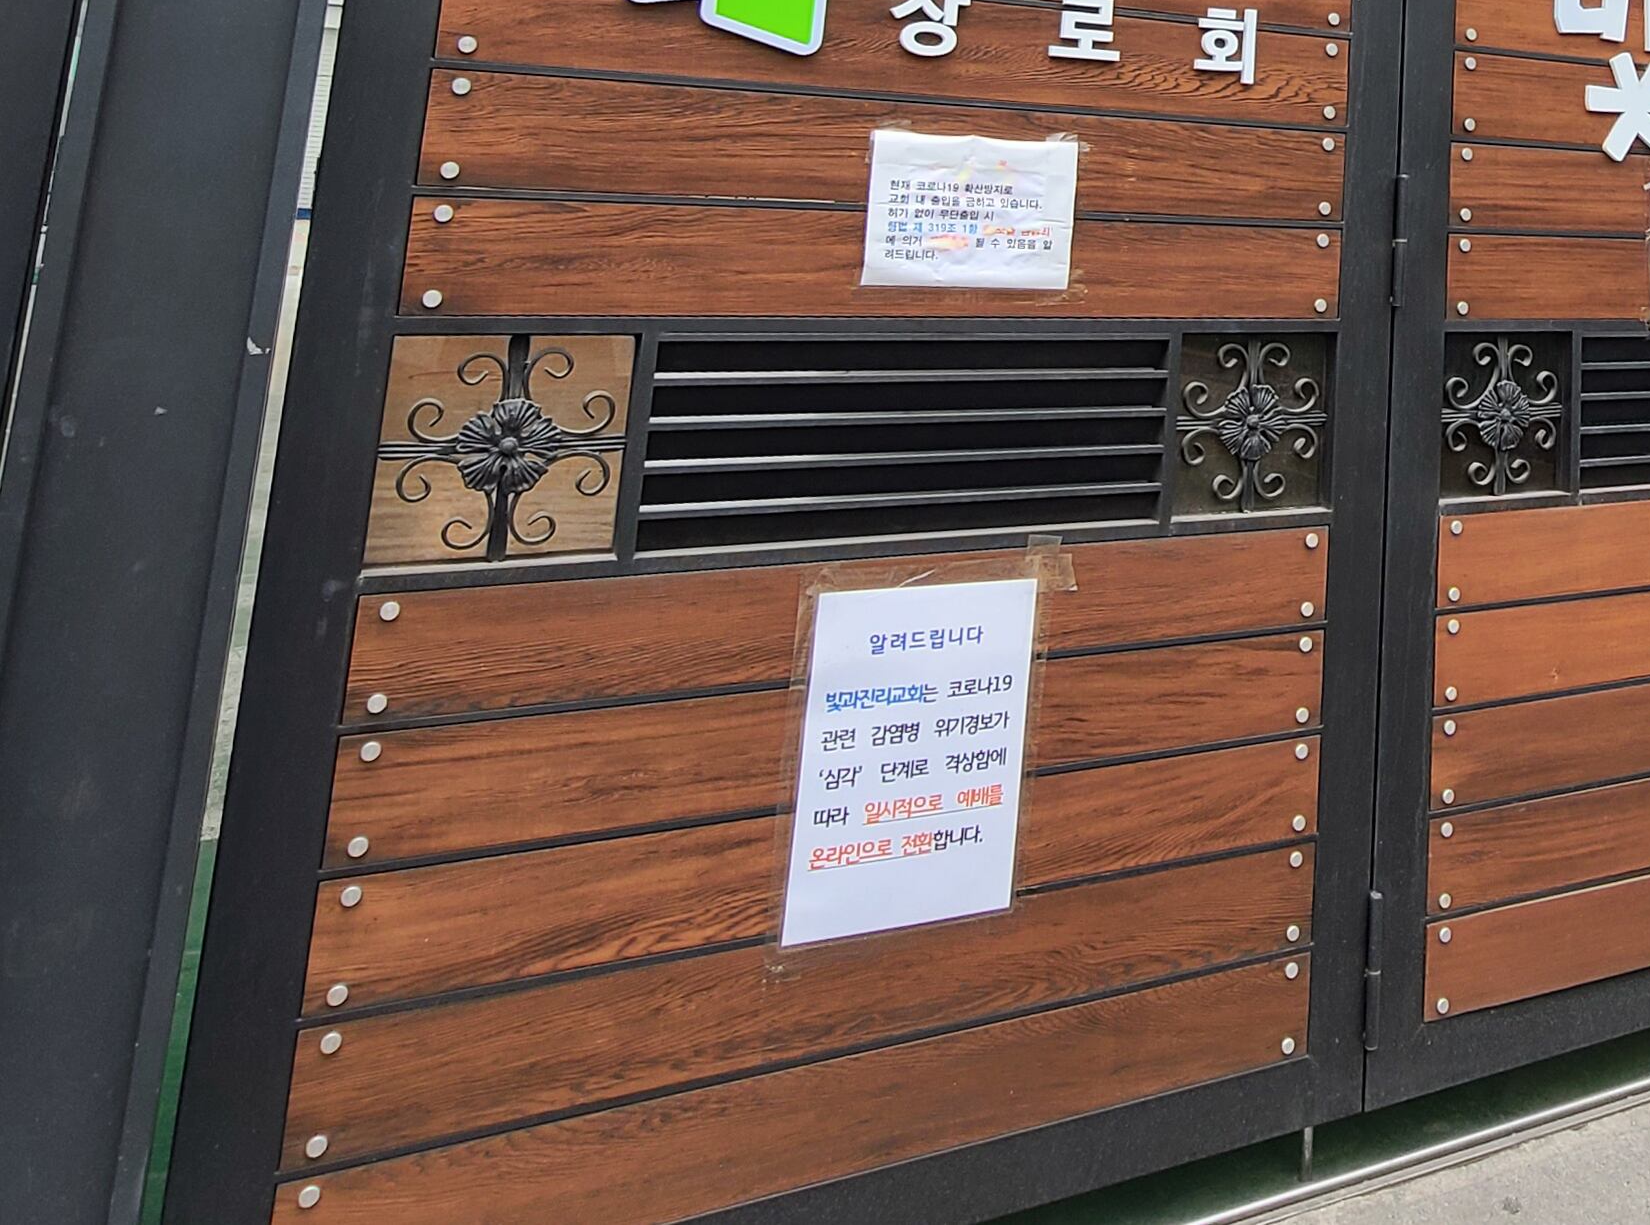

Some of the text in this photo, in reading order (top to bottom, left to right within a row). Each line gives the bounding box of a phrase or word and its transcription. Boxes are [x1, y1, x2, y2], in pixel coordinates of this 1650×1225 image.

[916, 181, 959, 193] 코로나19
[889, 194, 909, 204] 교회
[931, 196, 960, 207] 출입을
[966, 197, 995, 208] 금하고
[1001, 198, 1042, 210] 있습니다.
[914, 209, 934, 219] 없이
[939, 210, 979, 221] 무단출입
[984, 212, 994, 221] 시
[928, 223, 957, 233] 319조
[903, 236, 922, 246] 의거
[991, 238, 1000, 249] 수
[885, 249, 938, 261] 려드립니다.
[869, 625, 984, 655] 알려드립니다
[825, 674, 1013, 713] 빛과진리교회는 코로나19
[821, 711, 1009, 752] 관련 감염병 위기경보가
[880, 758, 929, 783] 단계로
[945, 748, 1008, 774] 격상함에
[813, 783, 1003, 829] 따라 일시적으로 예배를
[809, 826, 983, 869] 온라인으로 전환합니다.
